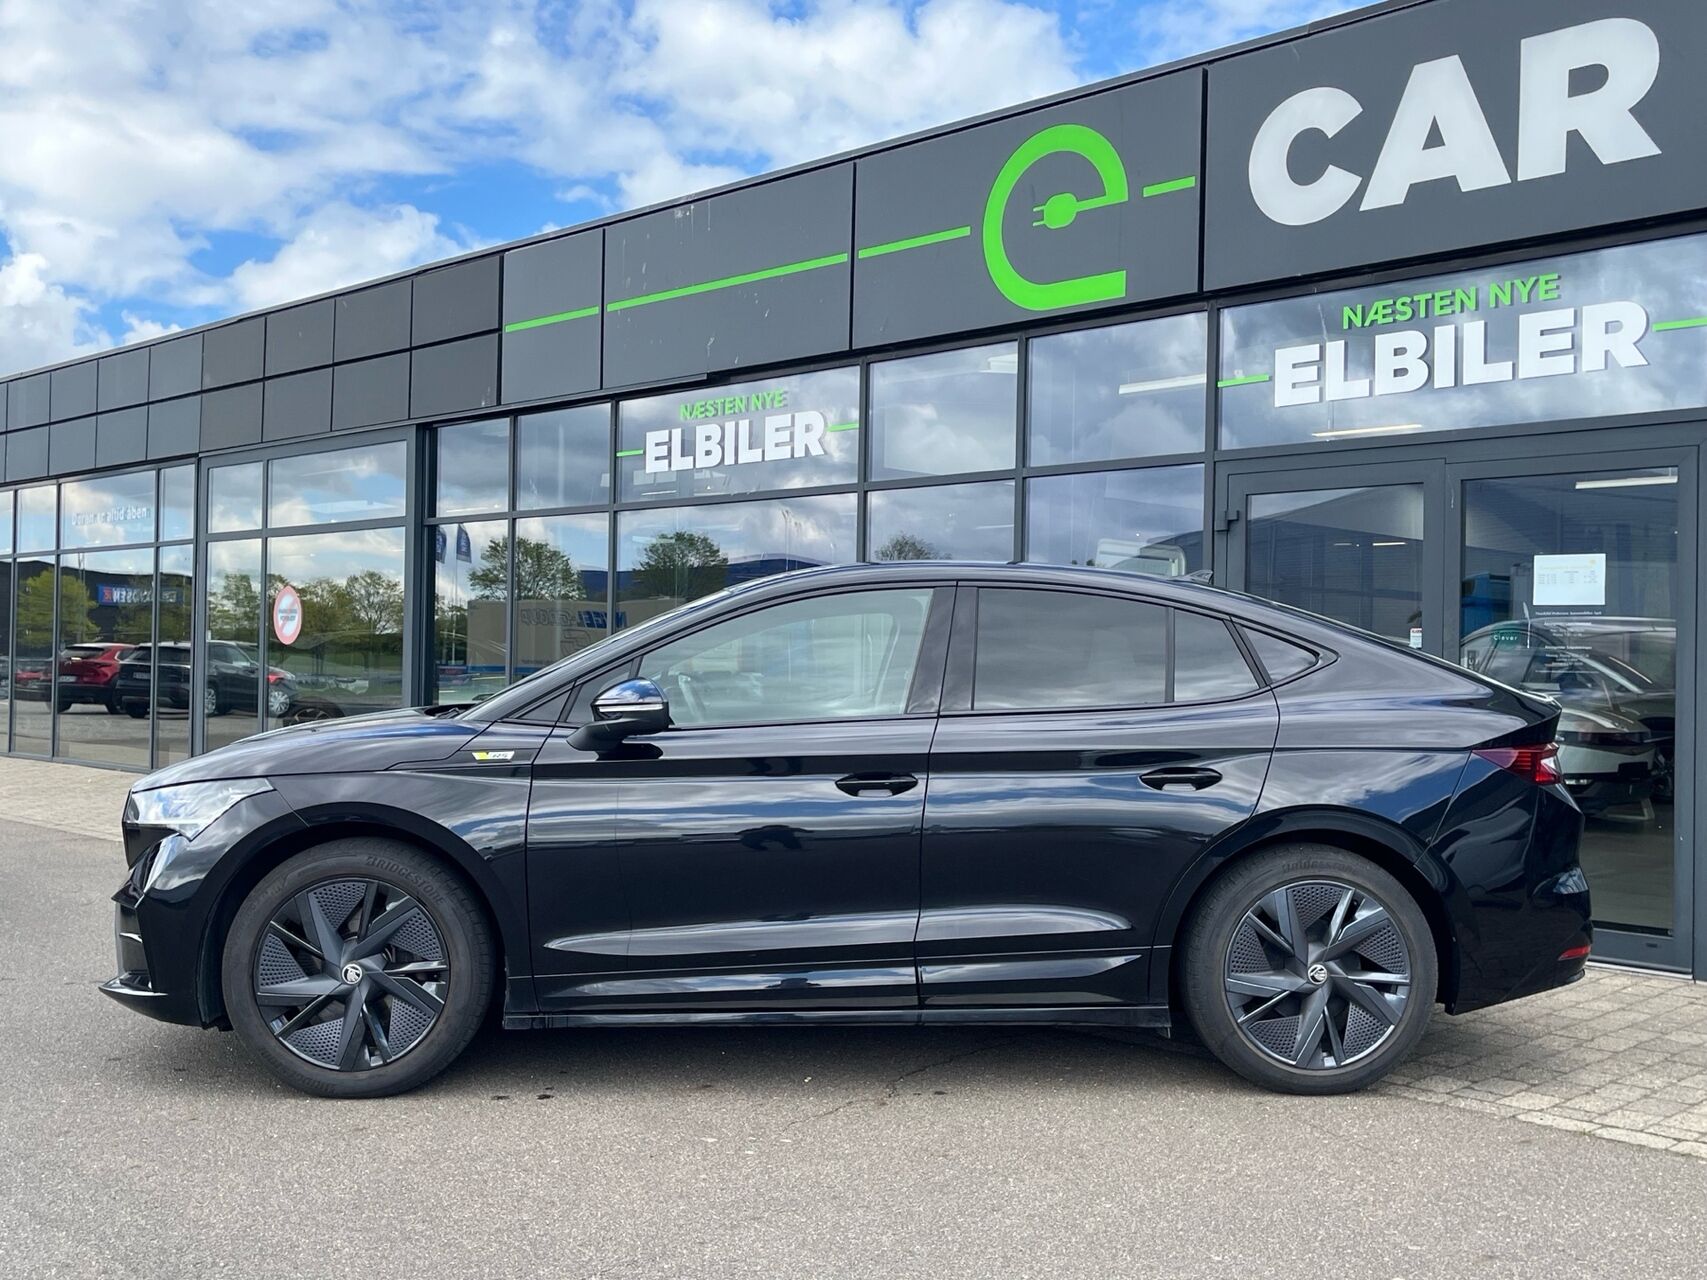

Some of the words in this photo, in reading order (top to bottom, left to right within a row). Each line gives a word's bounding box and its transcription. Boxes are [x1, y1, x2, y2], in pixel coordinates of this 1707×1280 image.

[1248, 17, 1662, 226] CAR
[1342, 286, 1477, 330] NÆSTEN
[1489, 273, 1561, 309] NYE
[1274, 300, 1649, 408] ELBILER
[679, 396, 746, 420] NÆSTEN
[751, 388, 785, 410] NYE
[645, 410, 825, 473] ELBILER
[365, 856, 446, 905] BRIDGESTONE
